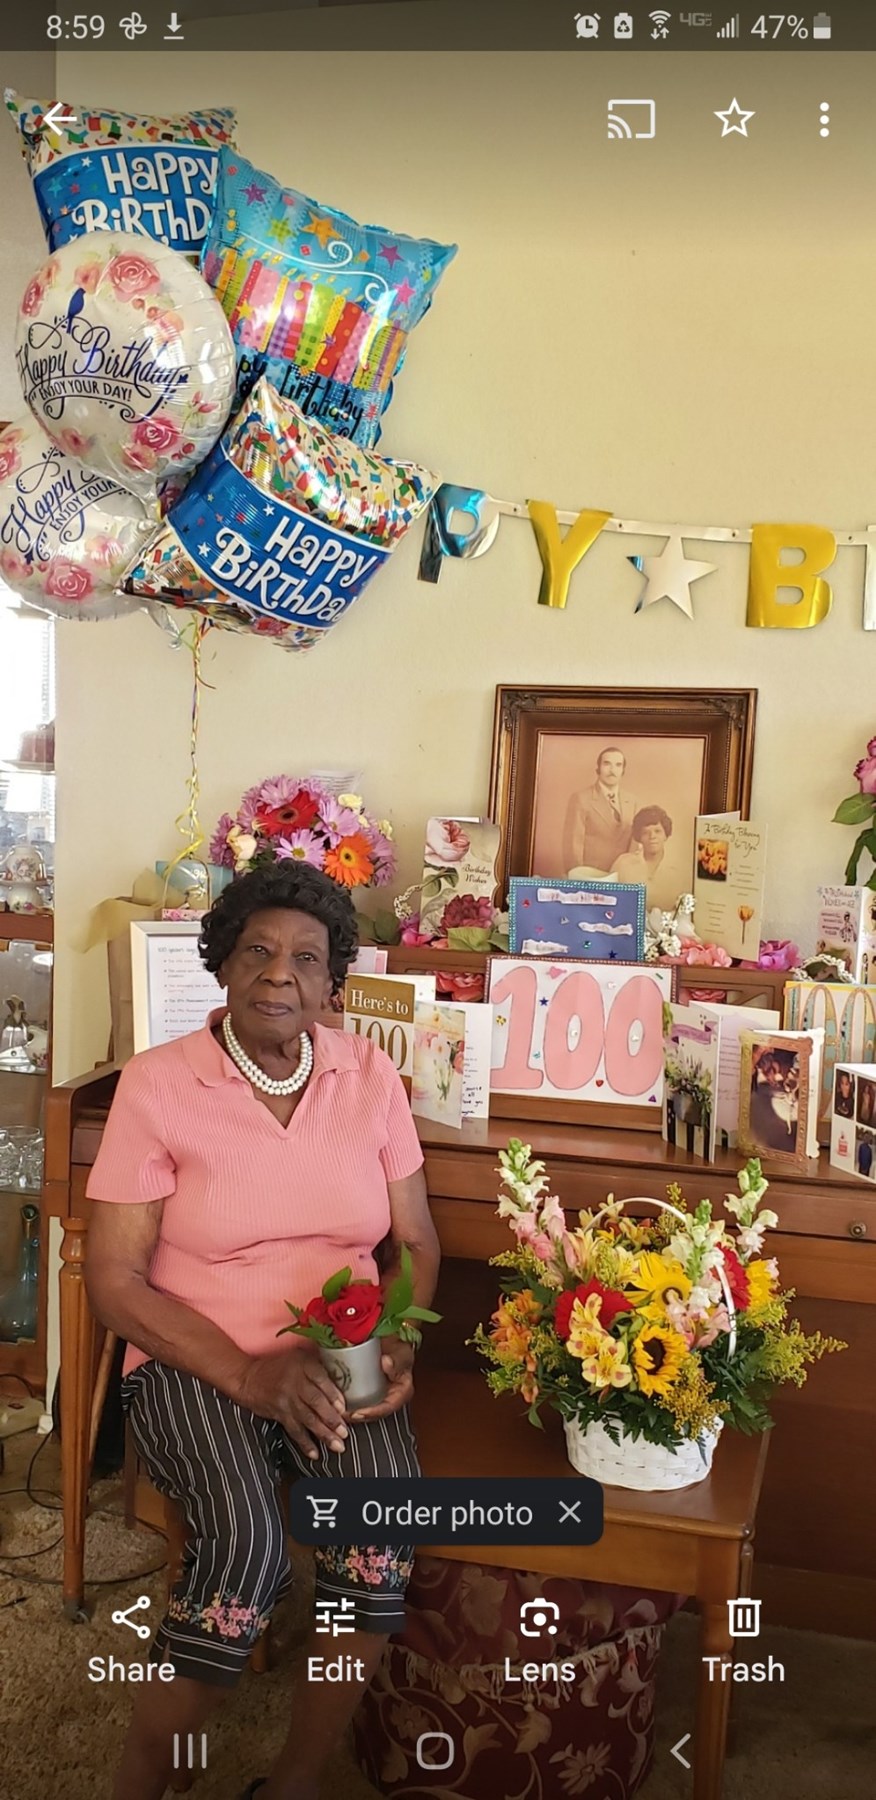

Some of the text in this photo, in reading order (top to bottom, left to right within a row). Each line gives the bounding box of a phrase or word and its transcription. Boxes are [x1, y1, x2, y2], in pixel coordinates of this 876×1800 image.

[15, 325, 179, 398] Happy Birthday
[39, 378, 132, 401] ENJOY YOUR DAY!
[1, 469, 76, 550] Happy
[49, 495, 84, 532] ENJOY
[351, 989, 409, 1016] Here's to
[490, 964, 664, 1096] 100
